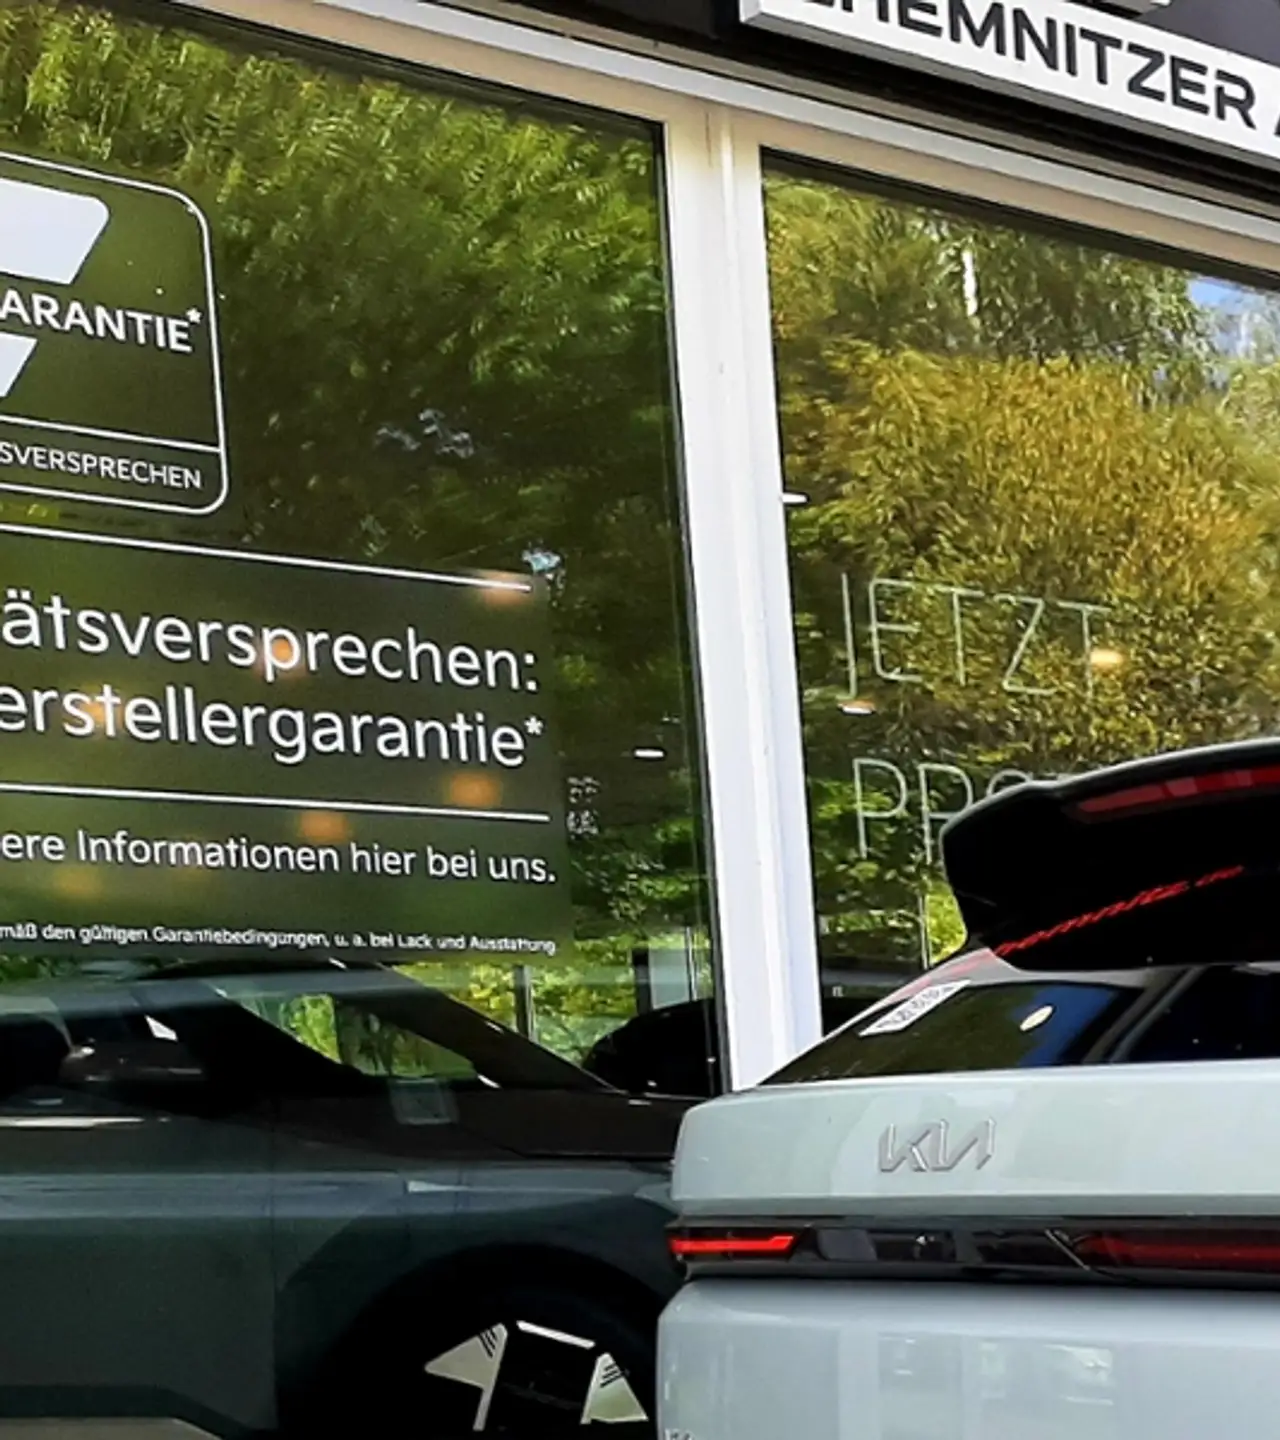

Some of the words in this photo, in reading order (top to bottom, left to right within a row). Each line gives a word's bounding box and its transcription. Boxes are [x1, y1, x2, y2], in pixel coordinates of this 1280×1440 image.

[804, 0, 1256, 129] EMNITZER
[838, 572, 1113, 703] JETZT
[78, 829, 339, 873] Informationen
[350, 842, 416, 875] hier
[426, 845, 478, 878] bei
[488, 855, 556, 883] uns.
[42, 924, 76, 940] den
[398, 934, 433, 949] Lack
